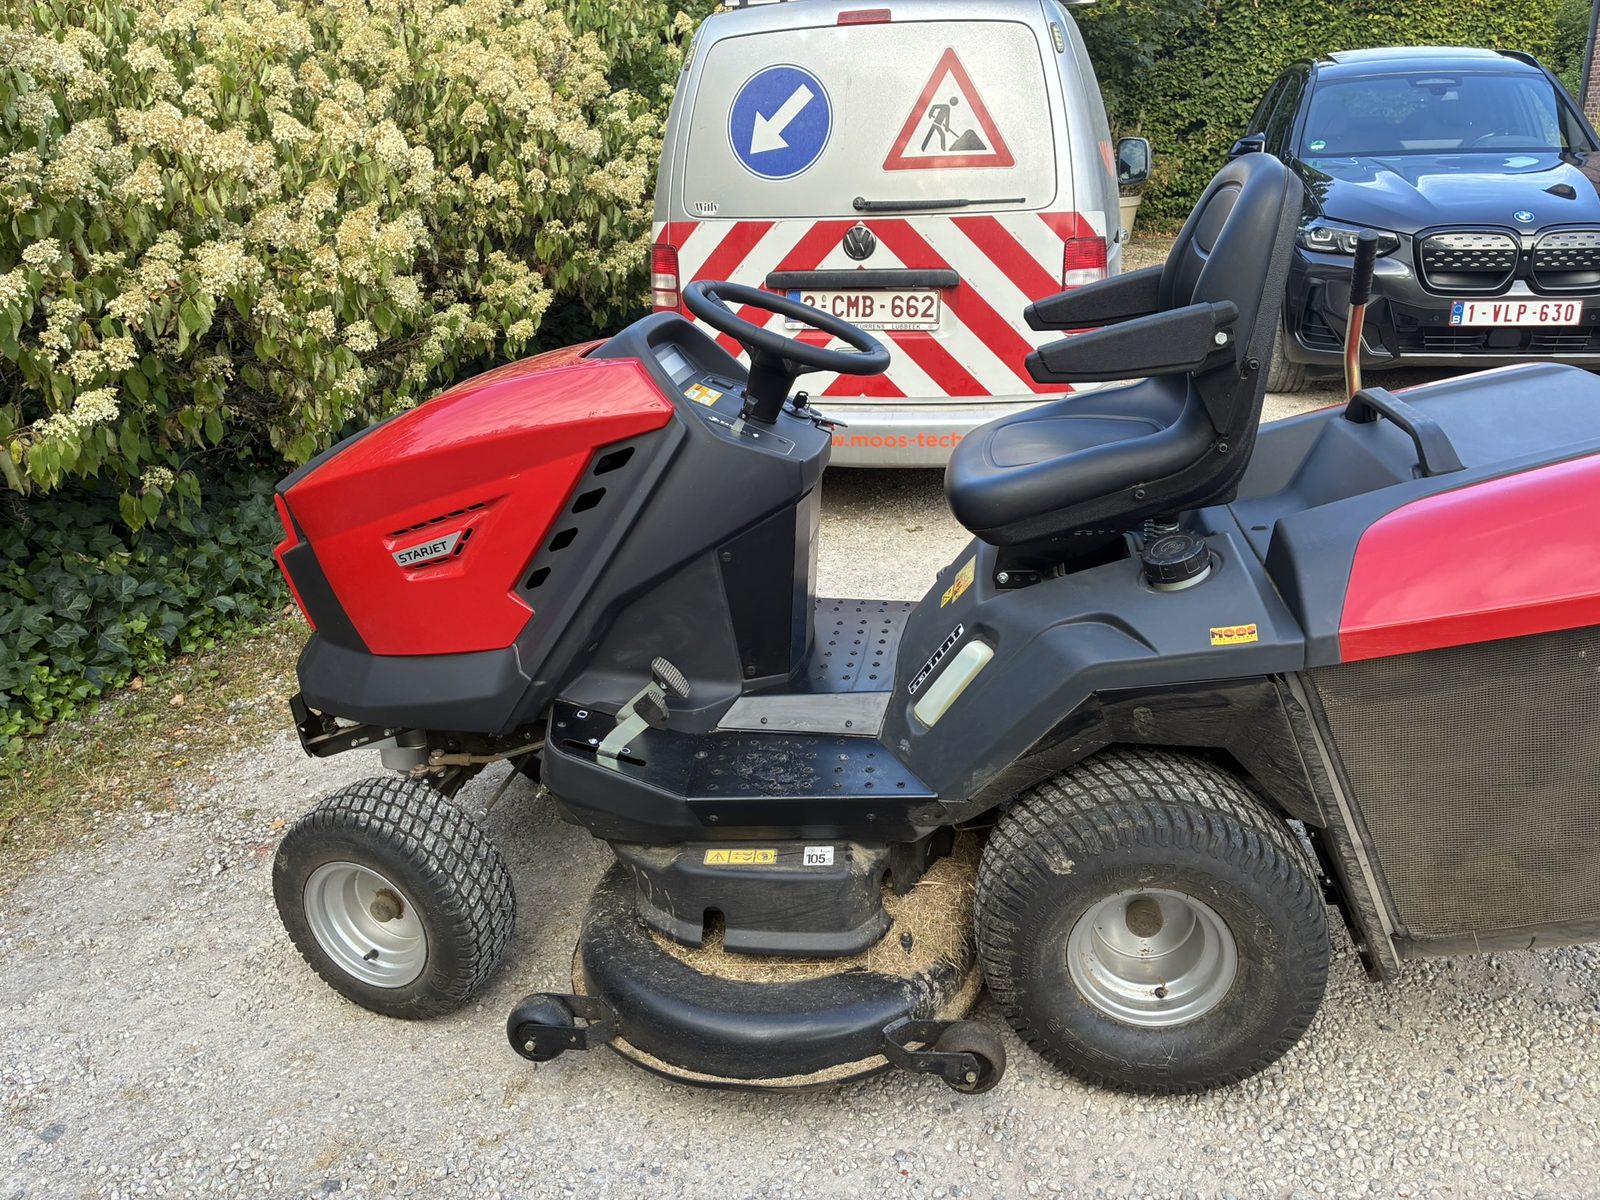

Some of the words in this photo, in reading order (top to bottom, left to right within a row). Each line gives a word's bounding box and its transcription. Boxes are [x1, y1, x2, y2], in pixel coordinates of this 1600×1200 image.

[1468, 304, 1575, 323] 1-VLP-630
[398, 540, 448, 564] STARJET
[1210, 625, 1256, 638] MOOS
[806, 853, 826, 864] 105
